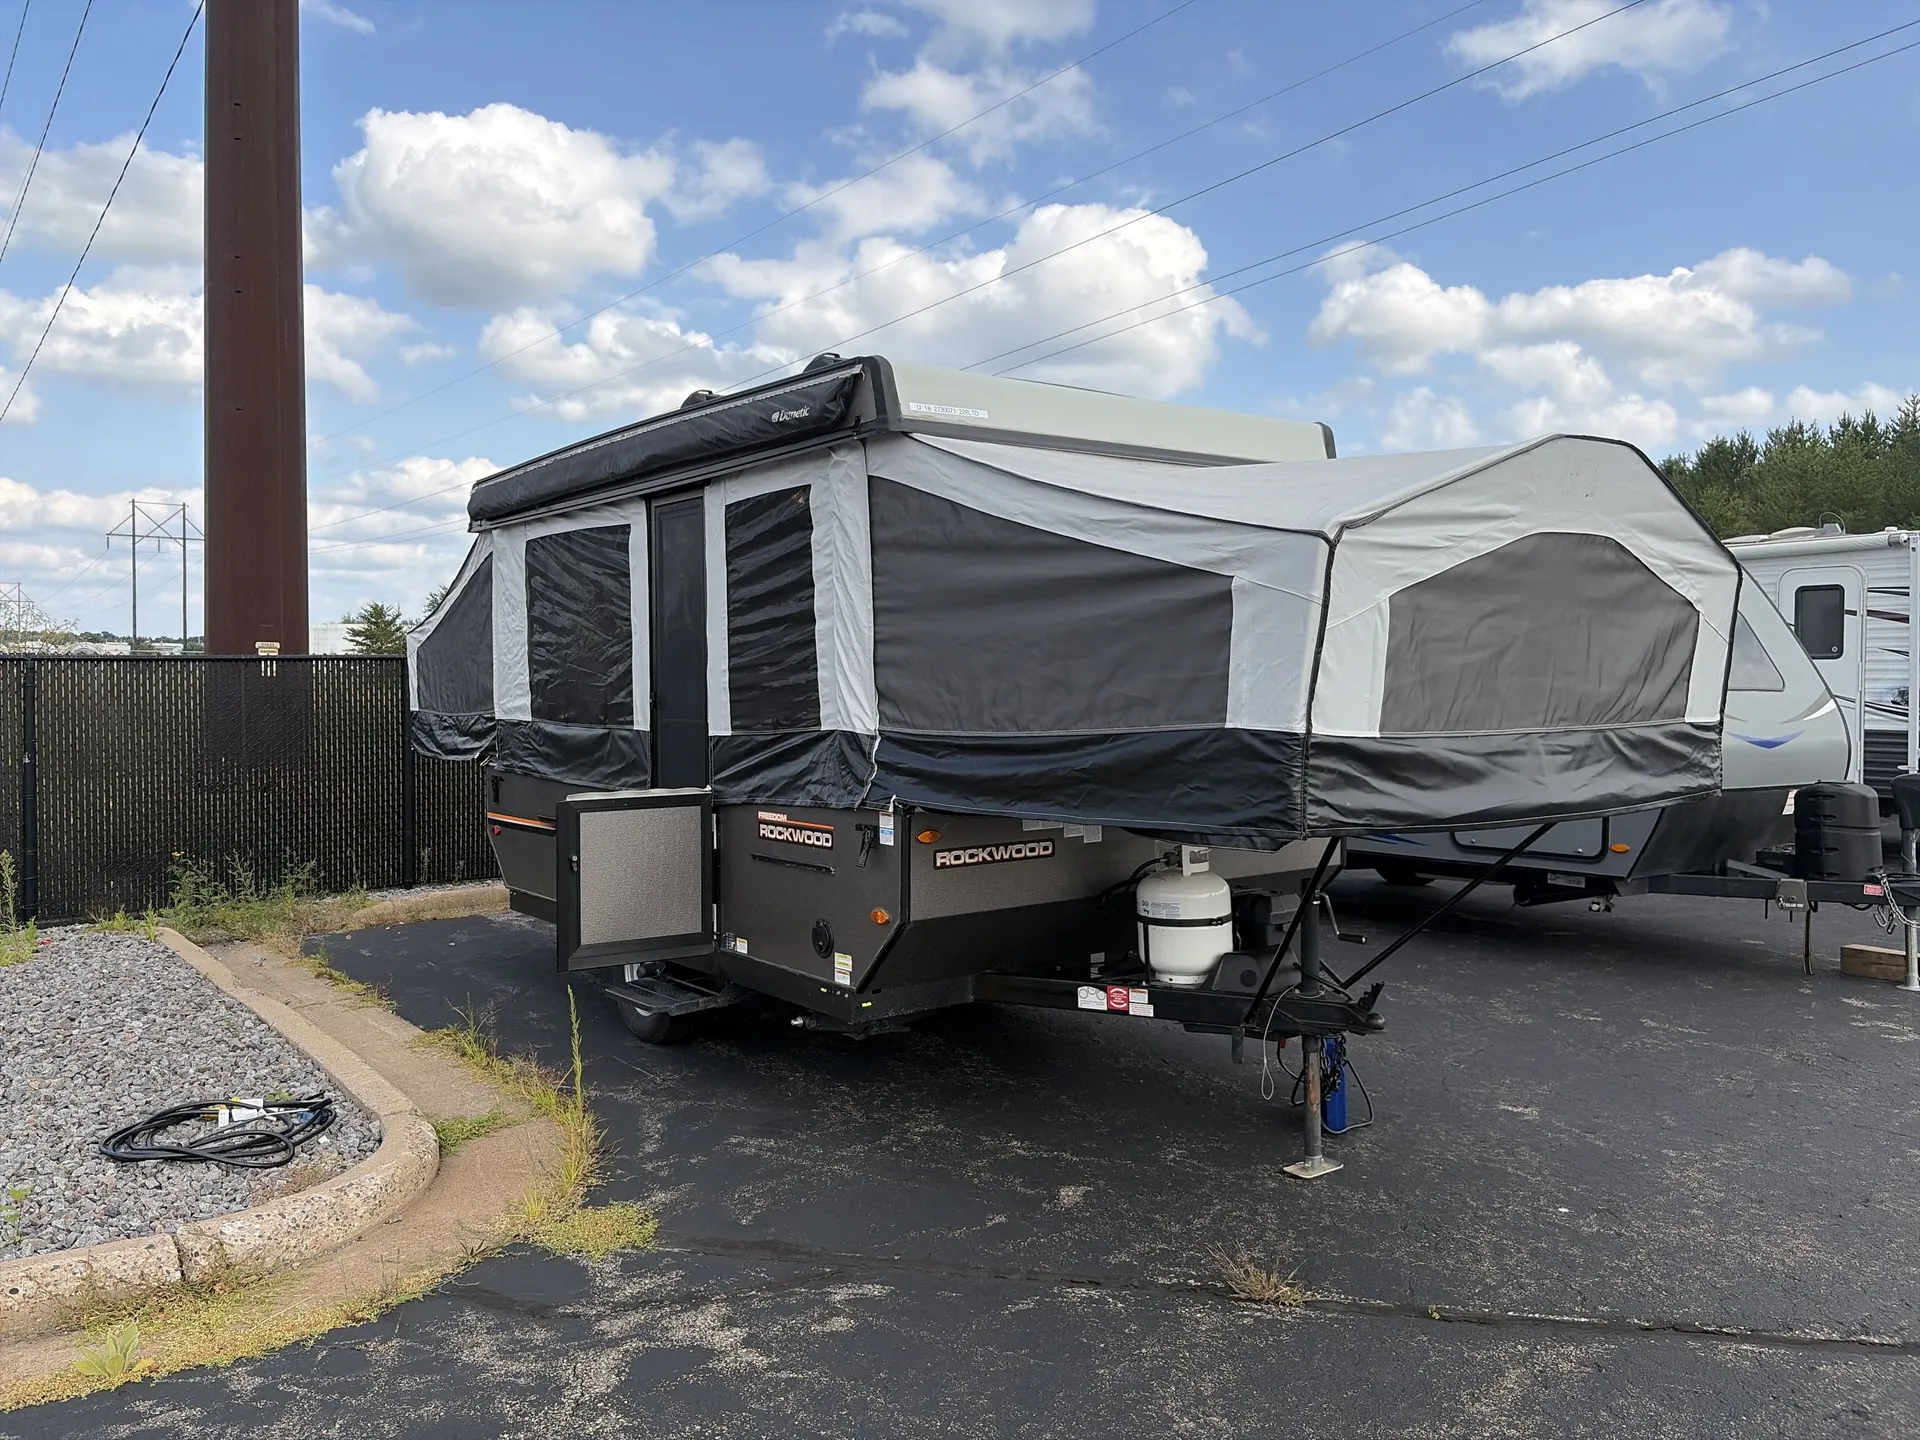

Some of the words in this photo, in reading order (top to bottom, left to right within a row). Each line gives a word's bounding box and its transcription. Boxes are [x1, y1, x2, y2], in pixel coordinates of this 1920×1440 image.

[758, 811, 788, 822] FREEDOM
[759, 823, 833, 847] ROCKWOOD
[935, 841, 1053, 867] ROCKWOOD
